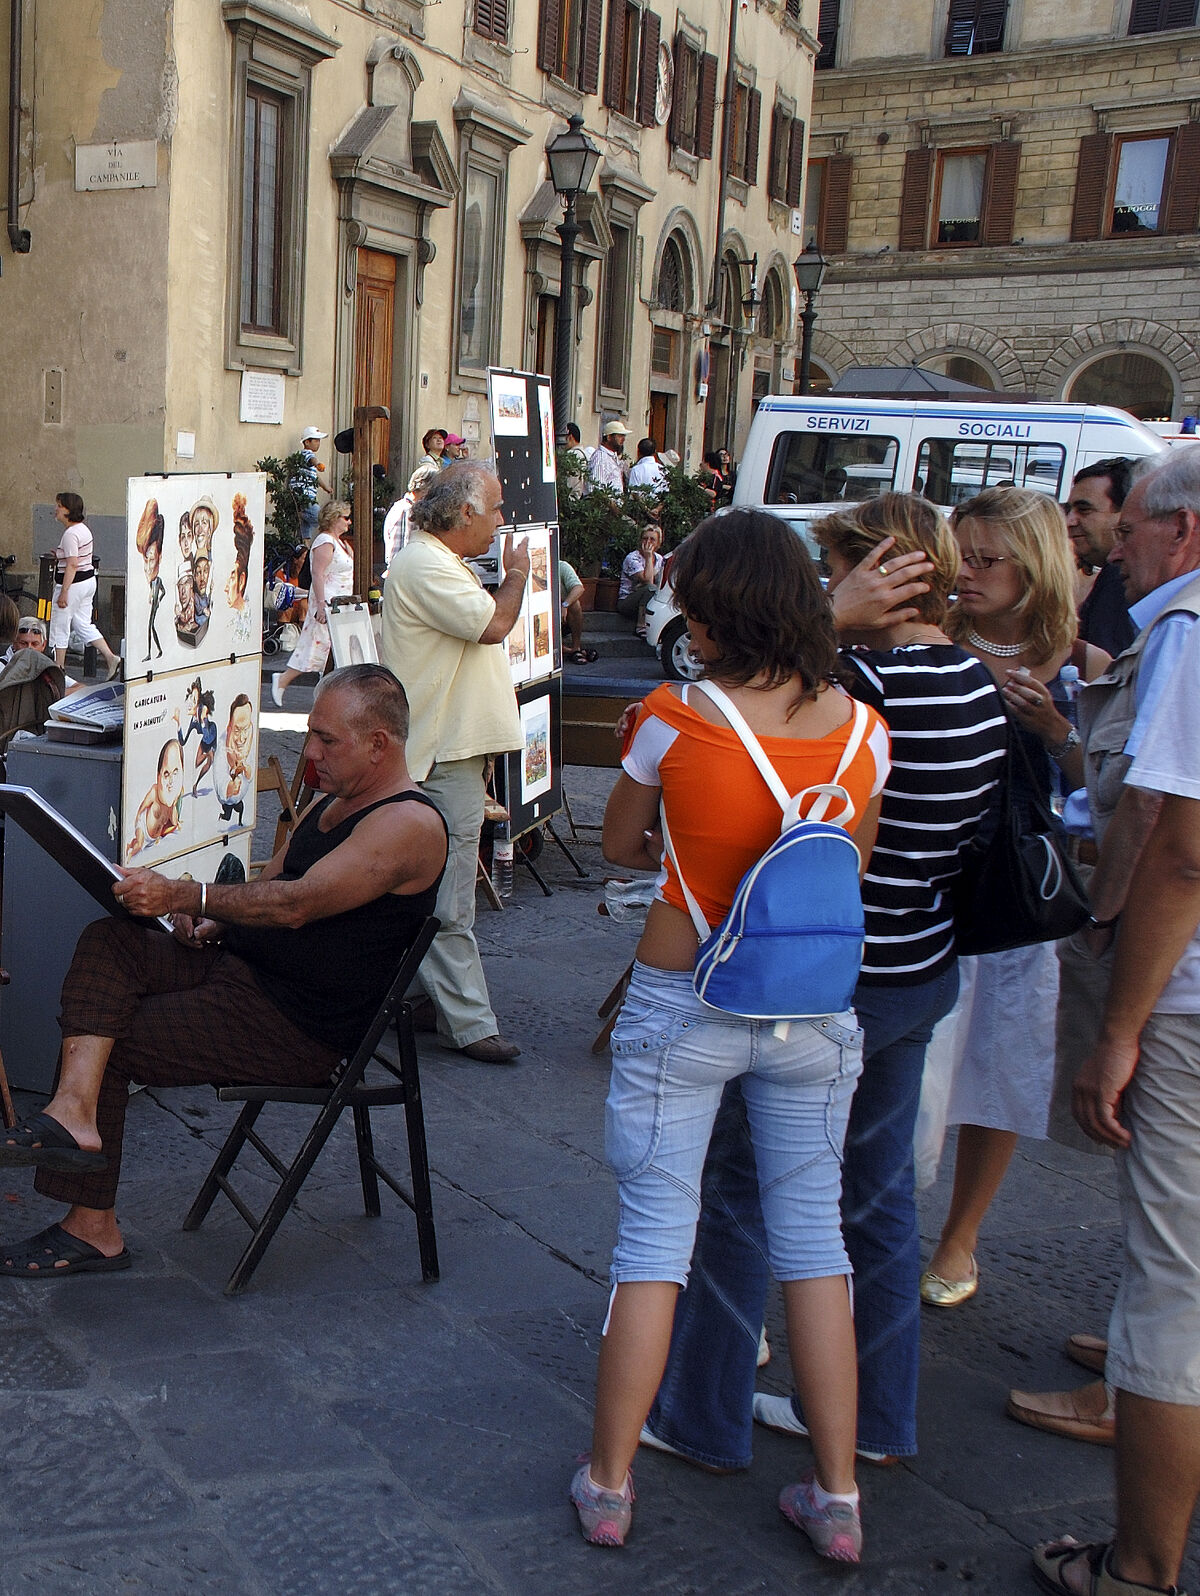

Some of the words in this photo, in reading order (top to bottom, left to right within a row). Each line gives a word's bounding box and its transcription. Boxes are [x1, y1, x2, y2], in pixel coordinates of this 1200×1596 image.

[106, 149, 123, 157] VIA
[108, 161, 122, 169] DEL
[89, 171, 140, 184] CAMPANILE
[806, 415, 870, 431] SERVIZI
[958, 421, 1031, 438] SOCIALI
[134, 693, 167, 708] CARICATURA
